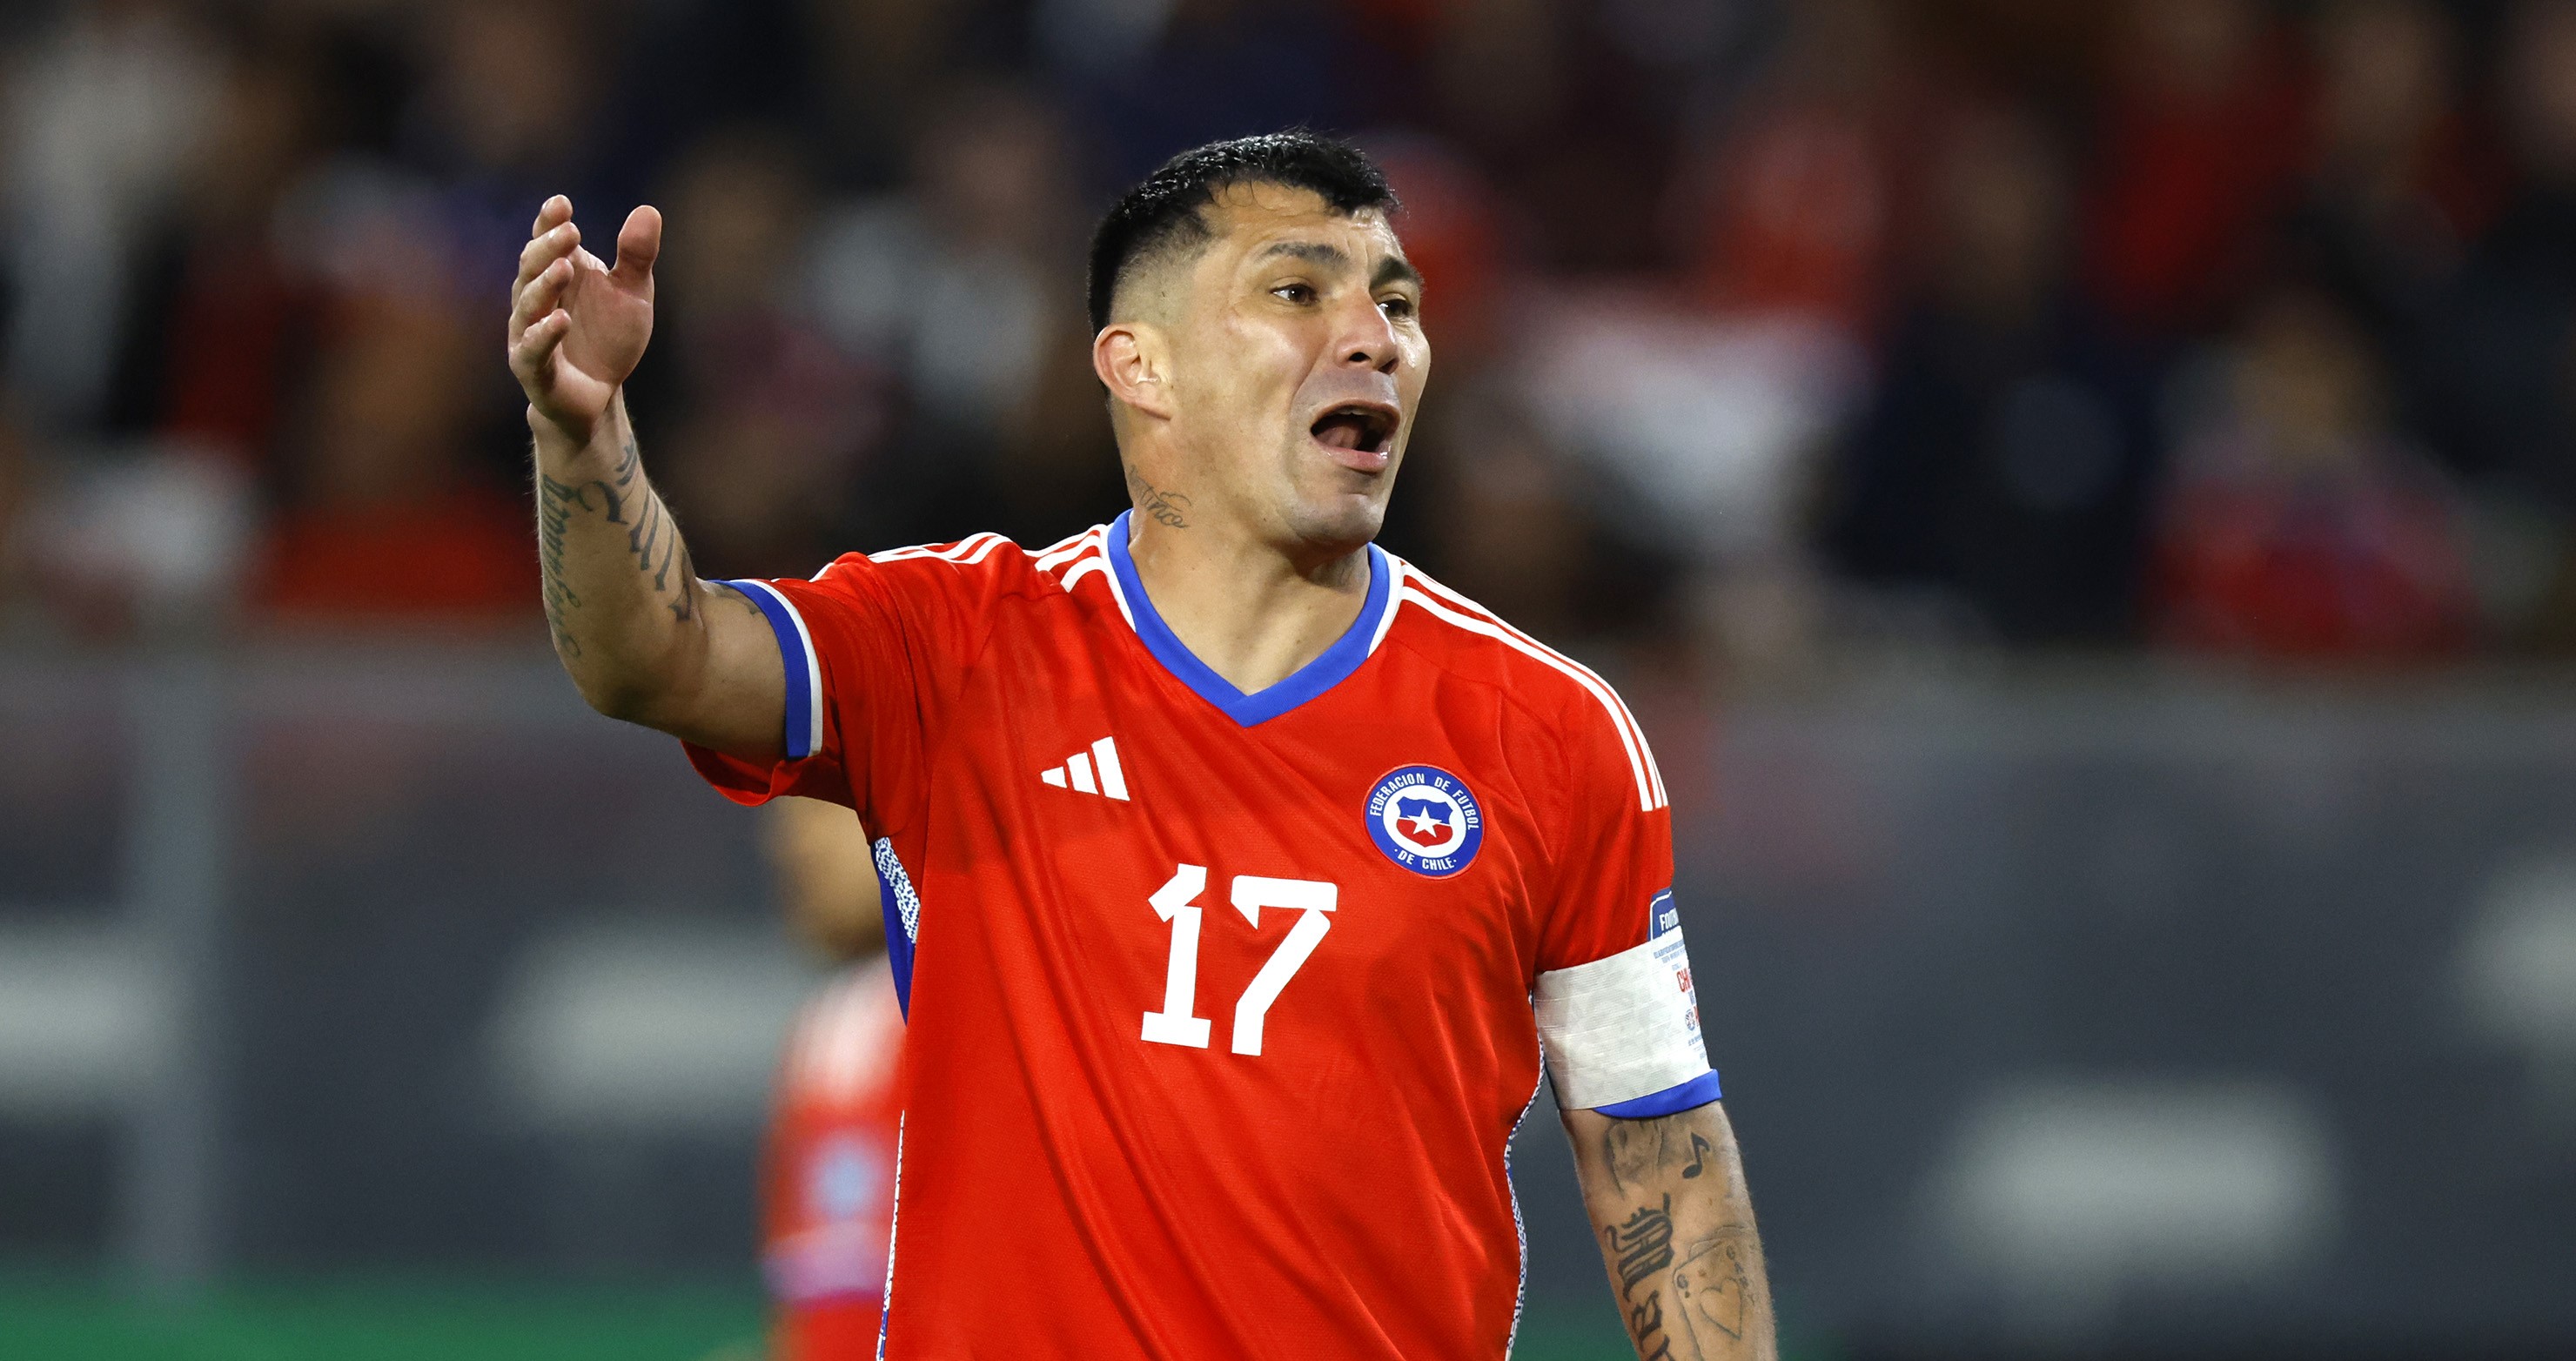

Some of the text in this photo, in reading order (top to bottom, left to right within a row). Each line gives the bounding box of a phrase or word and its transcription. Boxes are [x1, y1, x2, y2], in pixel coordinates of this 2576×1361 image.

[1369, 773, 1479, 830] FEDERACION DE FUTBOL
[1397, 849, 1455, 871] DE CHILE
[1140, 862, 1338, 1056] 17
